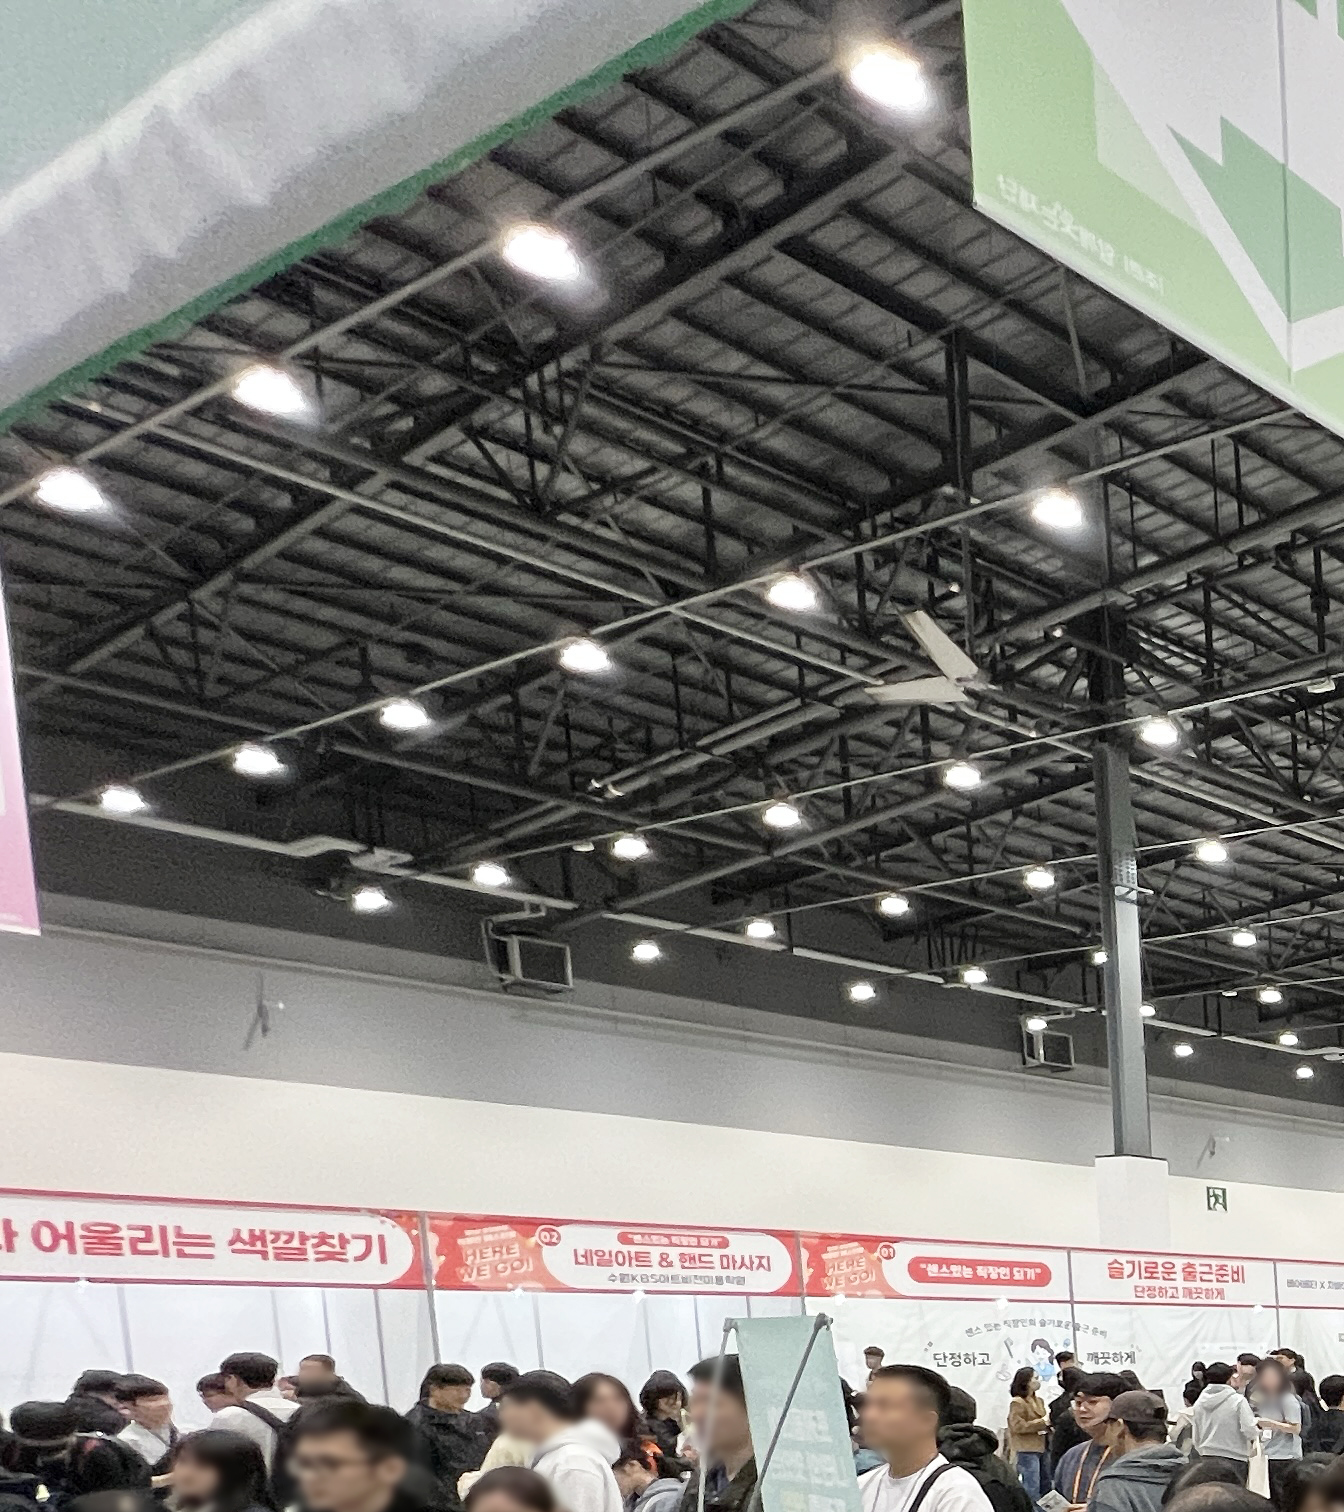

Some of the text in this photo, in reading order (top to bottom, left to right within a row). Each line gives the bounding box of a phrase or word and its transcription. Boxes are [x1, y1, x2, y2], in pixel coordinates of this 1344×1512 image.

[31, 1220, 215, 1260] 어울리는
[228, 1228, 388, 1264] 색깔찾기
[573, 1249, 771, 1272] 네일아트 & 핸드 마사지
[1107, 1258, 1246, 1284] 슬기로운 출근준비
[1134, 1286, 1226, 1301] 단정하고 깨끗하게
[933, 1351, 1136, 1368] 단정하고 깨끗하게
